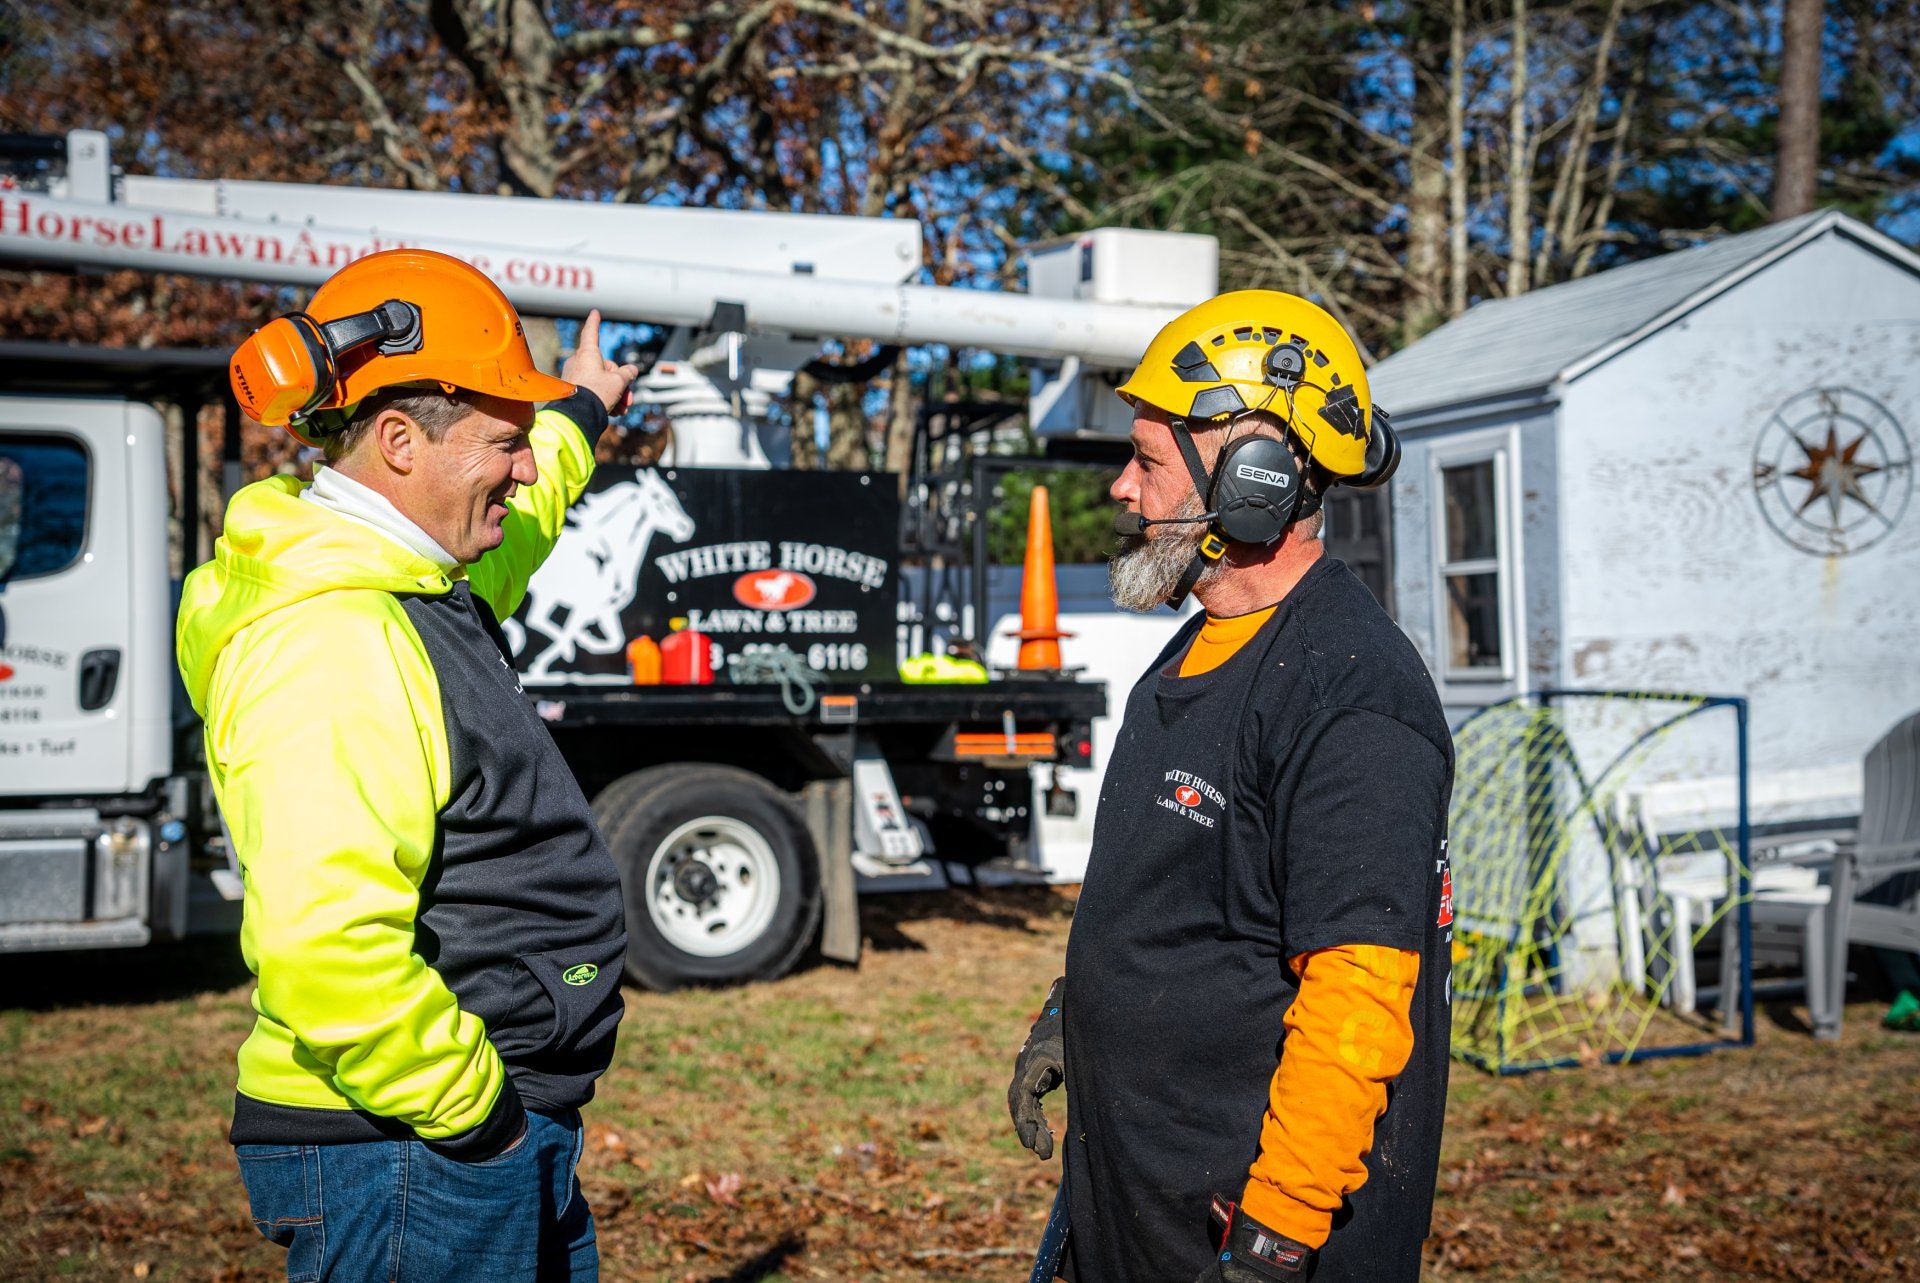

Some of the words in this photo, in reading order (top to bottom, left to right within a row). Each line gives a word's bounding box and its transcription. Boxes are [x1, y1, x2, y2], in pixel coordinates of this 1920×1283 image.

[234, 364, 256, 406] STIHL
[1240, 467, 1286, 486] SENA
[655, 541, 771, 583] WHITE
[779, 541, 888, 588] HORSE
[687, 610, 763, 633] LAWN
[764, 610, 786, 633] &
[787, 610, 858, 634] TREE
[1192, 776, 1227, 811] HORSE
[1156, 795, 1180, 813] LAWN
[1179, 806, 1187, 816] &
[1188, 808, 1215, 828] TREE
